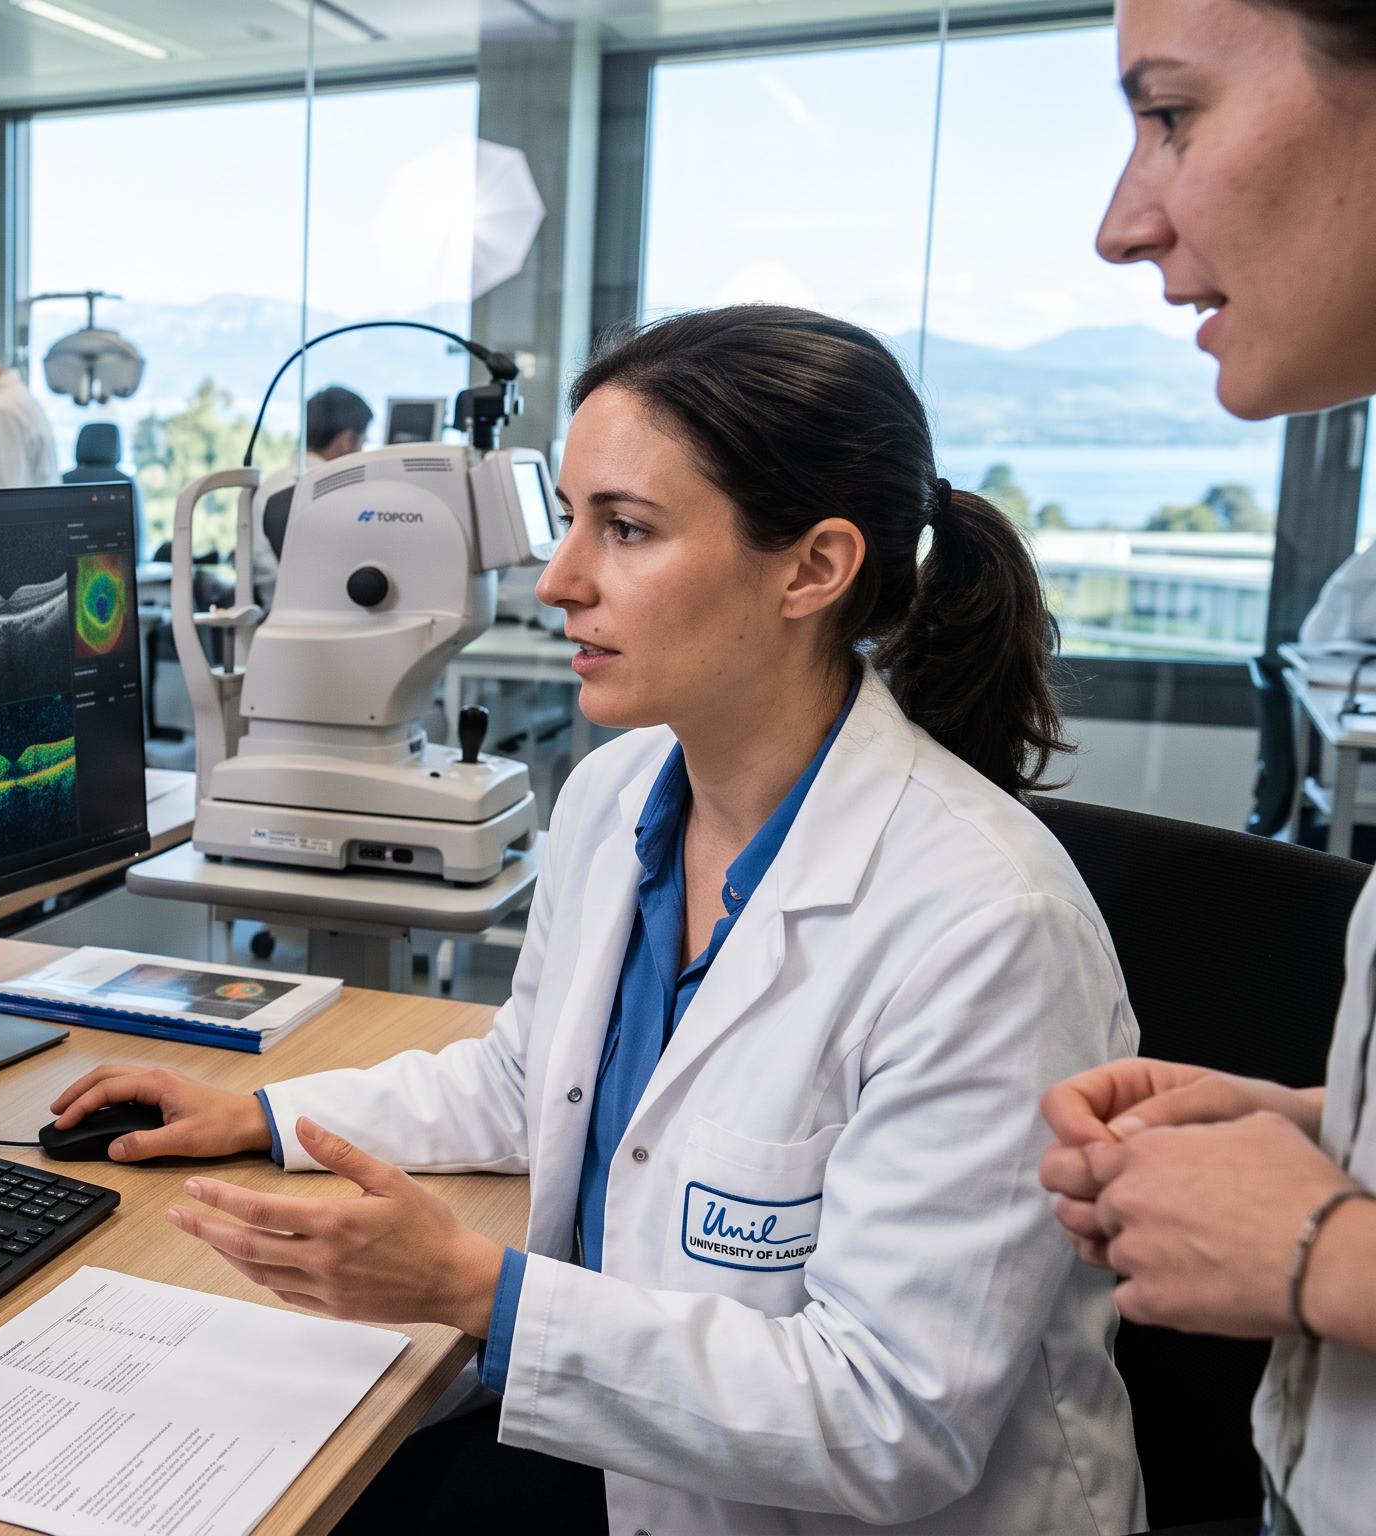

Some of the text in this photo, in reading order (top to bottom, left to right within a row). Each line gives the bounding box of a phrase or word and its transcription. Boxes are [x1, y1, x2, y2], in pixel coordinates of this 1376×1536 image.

[703, 1201, 811, 1245] Unil
[689, 1236, 754, 1259] UNIVERSITY
[756, 1250, 772, 1260] OF
